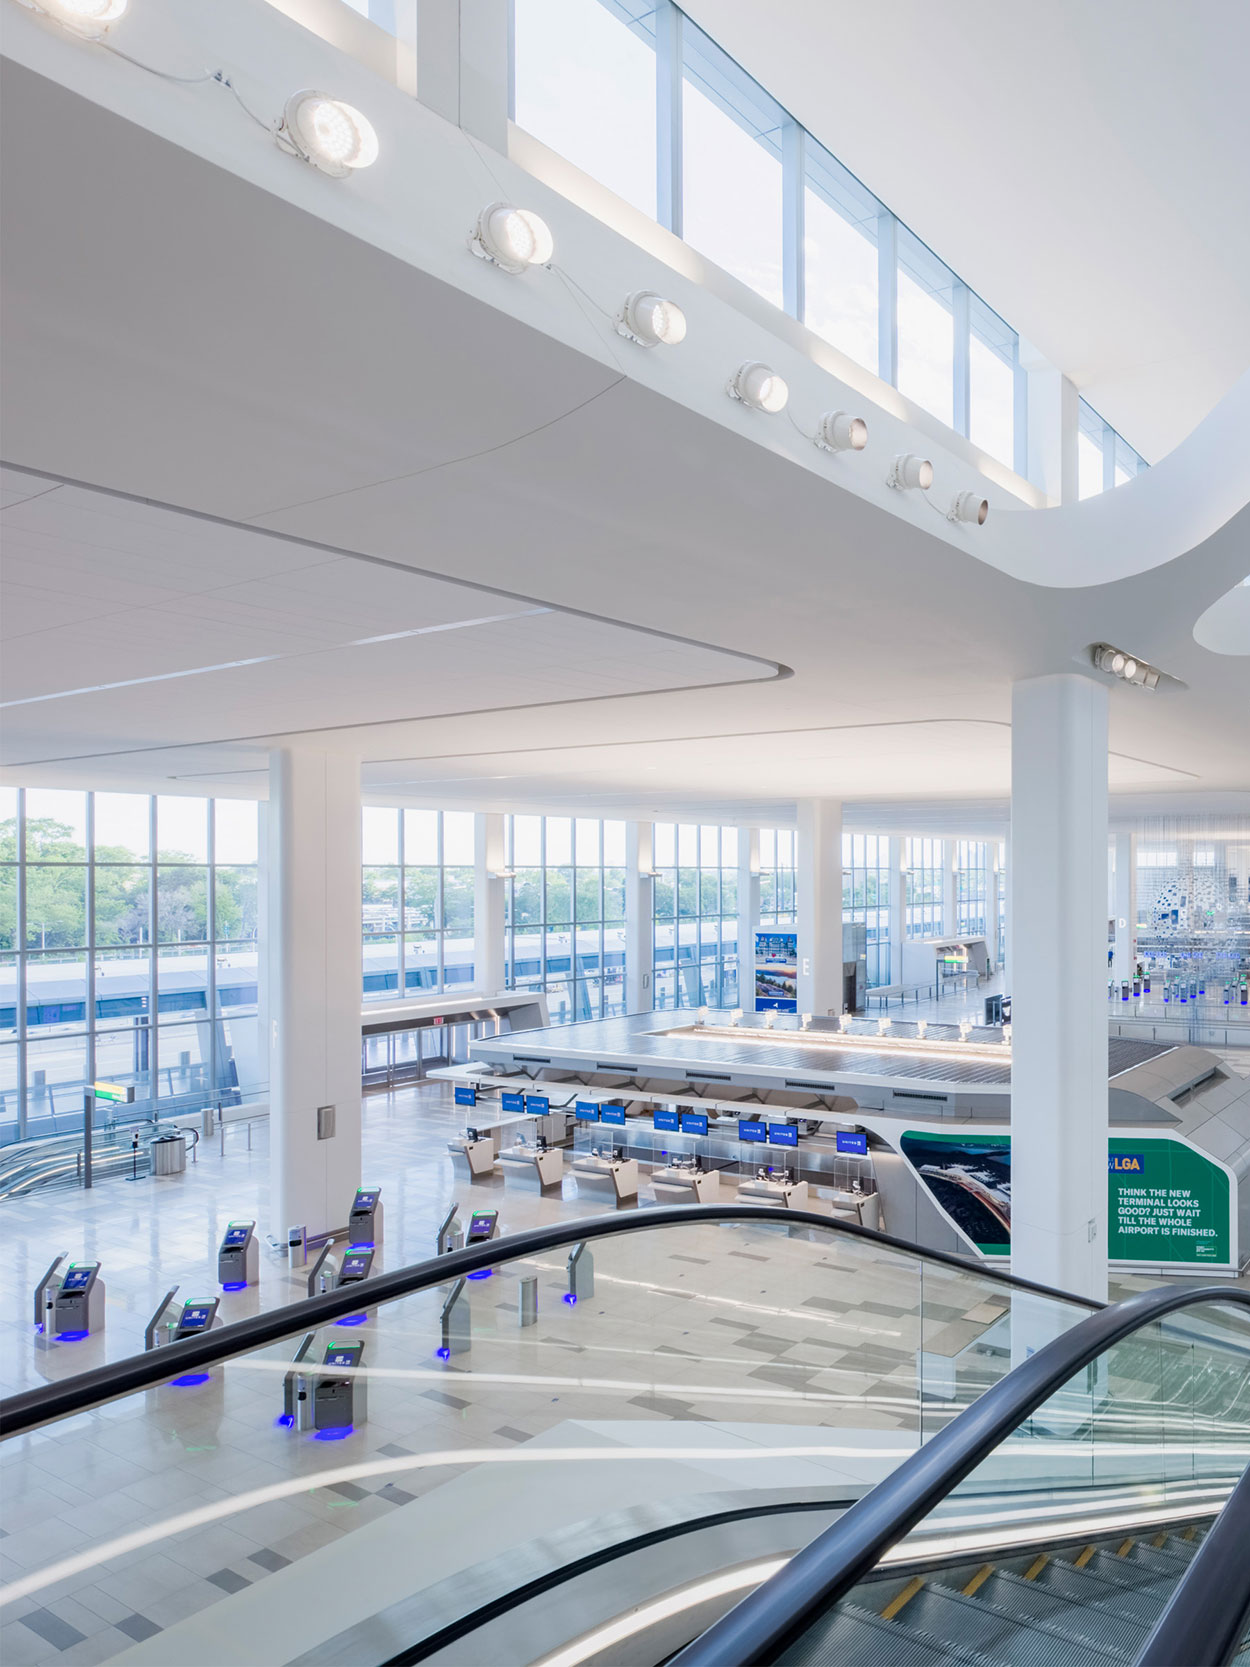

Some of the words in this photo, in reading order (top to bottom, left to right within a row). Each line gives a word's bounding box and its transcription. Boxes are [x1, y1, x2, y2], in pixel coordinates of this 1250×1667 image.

[1119, 918, 1127, 928] D
[802, 958, 810, 976] E
[1114, 1158, 1140, 1170] LGA
[1118, 1188, 1147, 1197] THINK
[1149, 1189, 1167, 1197] THE
[1169, 1190, 1191, 1198] NEW
[1118, 1198, 1166, 1207] TERMINAL
[1167, 1199, 1199, 1207] LOOKS
[1118, 1207, 1150, 1216] GOOD?
[1152, 1208, 1174, 1216] JUST
[1176, 1209, 1201, 1217] WAIT
[1118, 1217, 1136, 1225] TILL
[1138, 1217, 1156, 1225] THE
[1158, 1218, 1192, 1226] WHOLE
[1172, 1229, 1218, 1237] FINISHED.
